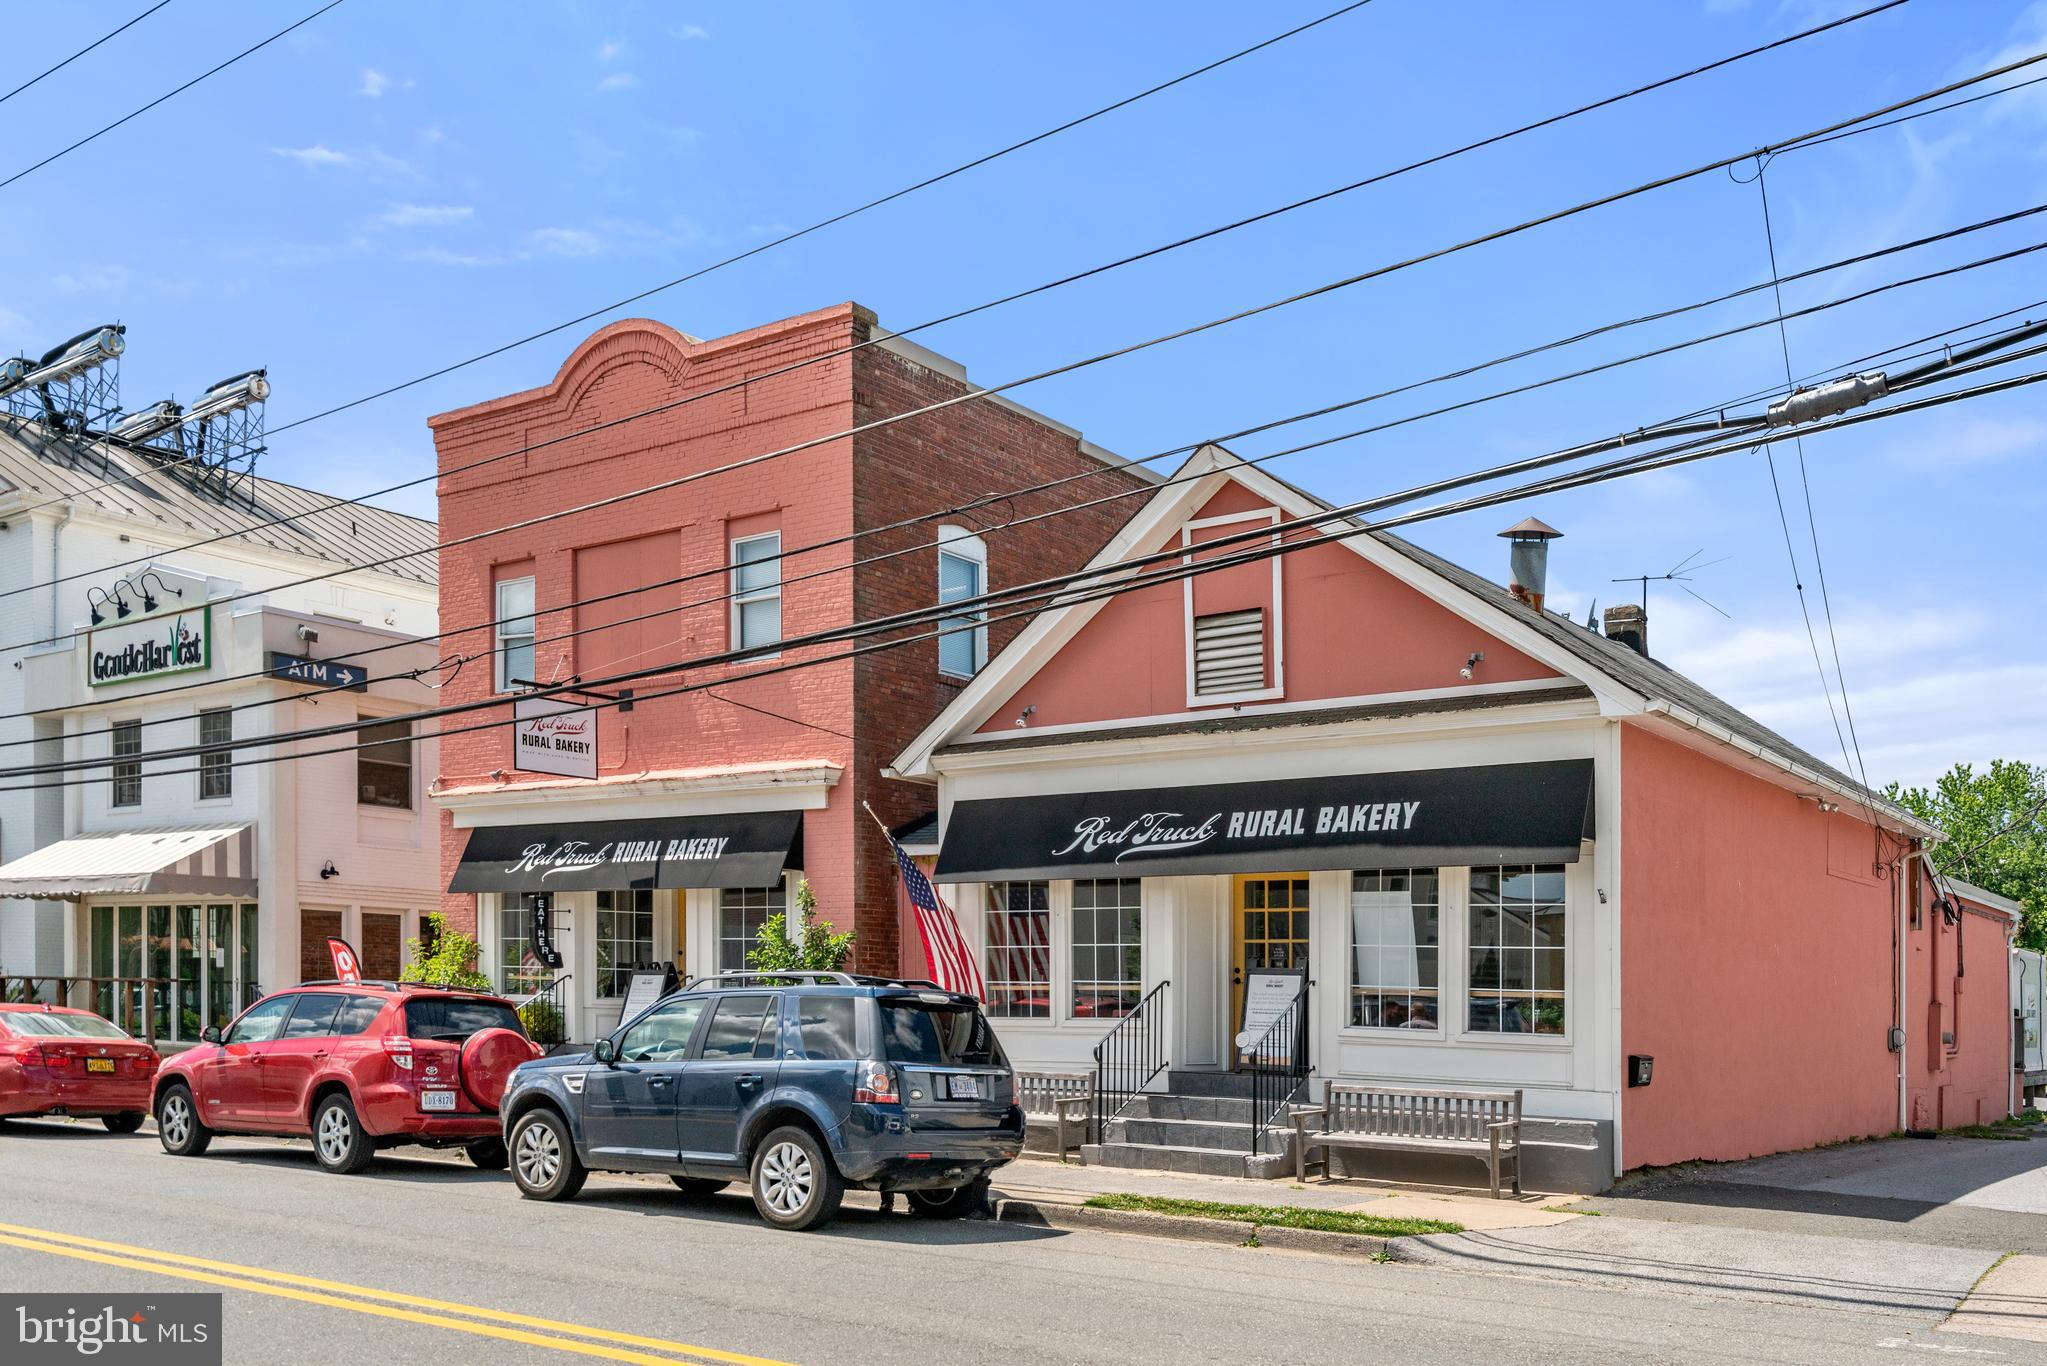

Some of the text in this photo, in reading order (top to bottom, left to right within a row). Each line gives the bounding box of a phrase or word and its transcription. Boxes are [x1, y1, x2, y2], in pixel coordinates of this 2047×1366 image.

[288, 660, 327, 681] ATM
[524, 715, 589, 737] Red Truck
[522, 733, 591, 755] RURAL BAKERY
[1051, 801, 1421, 865] Red Truck RURAL BAKERY
[504, 837, 729, 882] Red Truck RURAL BAKERY
[537, 899, 555, 963] EAT HERE
